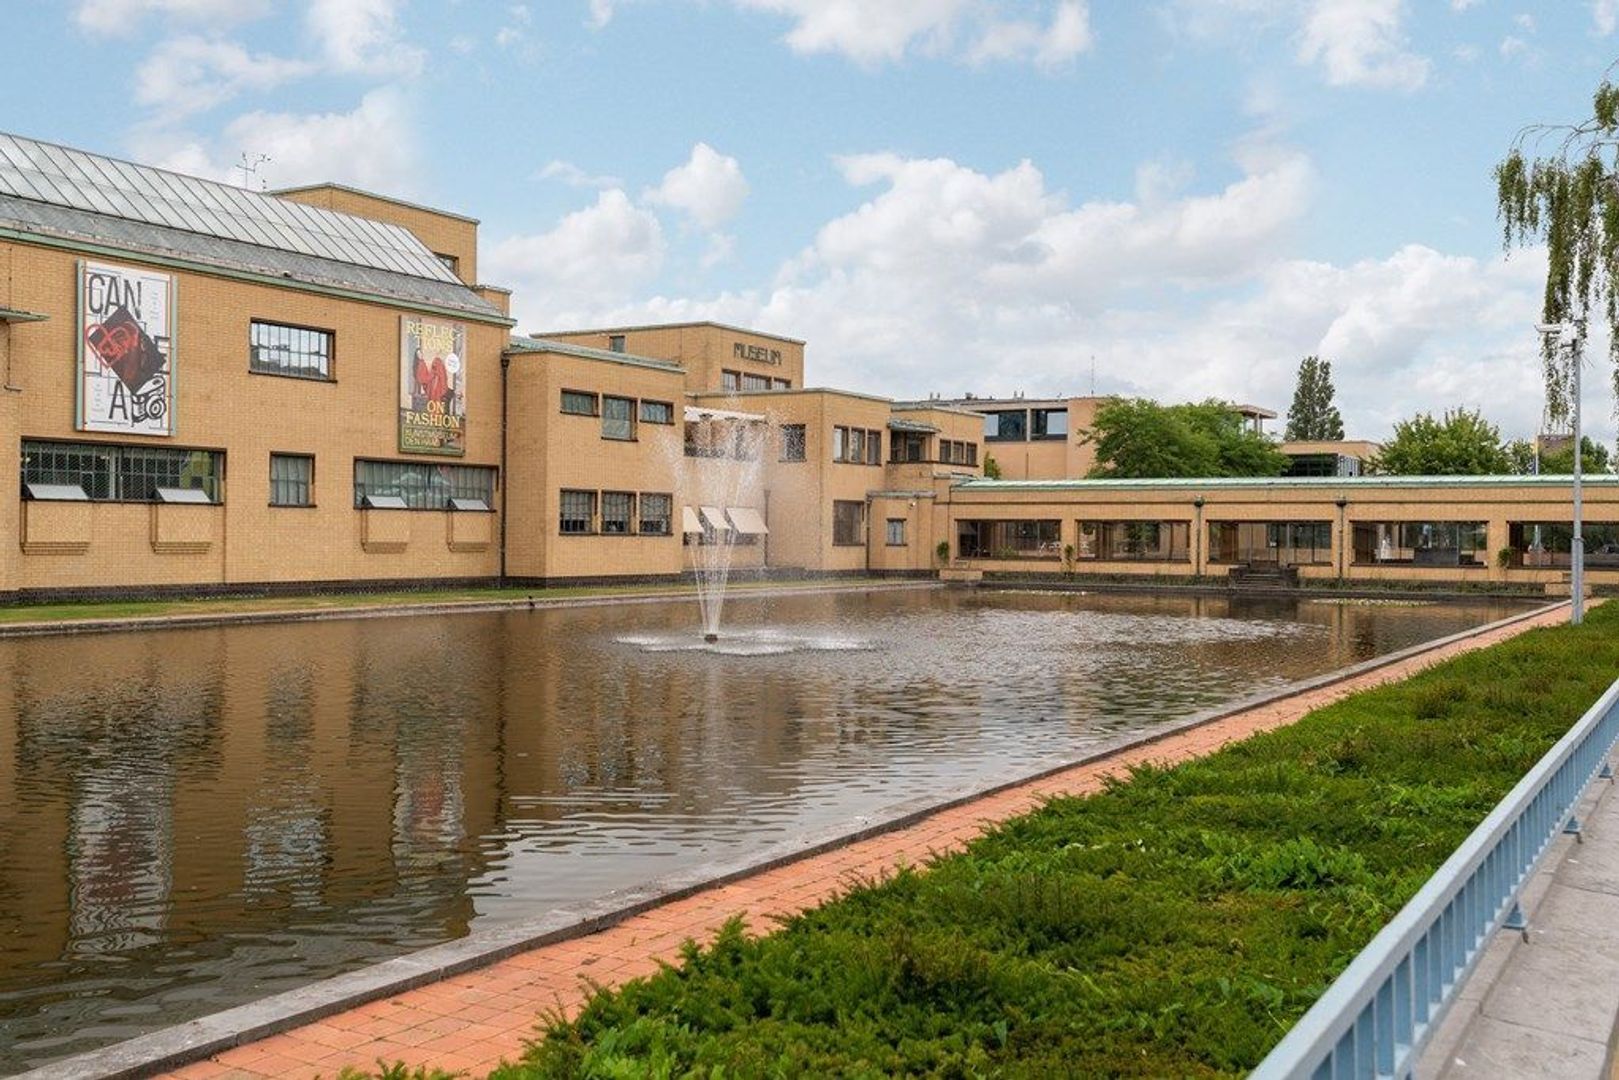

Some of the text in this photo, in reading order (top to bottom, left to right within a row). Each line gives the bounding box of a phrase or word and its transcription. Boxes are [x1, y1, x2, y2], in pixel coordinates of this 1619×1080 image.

[734, 342, 782, 366] MUSEUM
[427, 400, 446, 414] ON
[406, 411, 460, 428] FASHION
